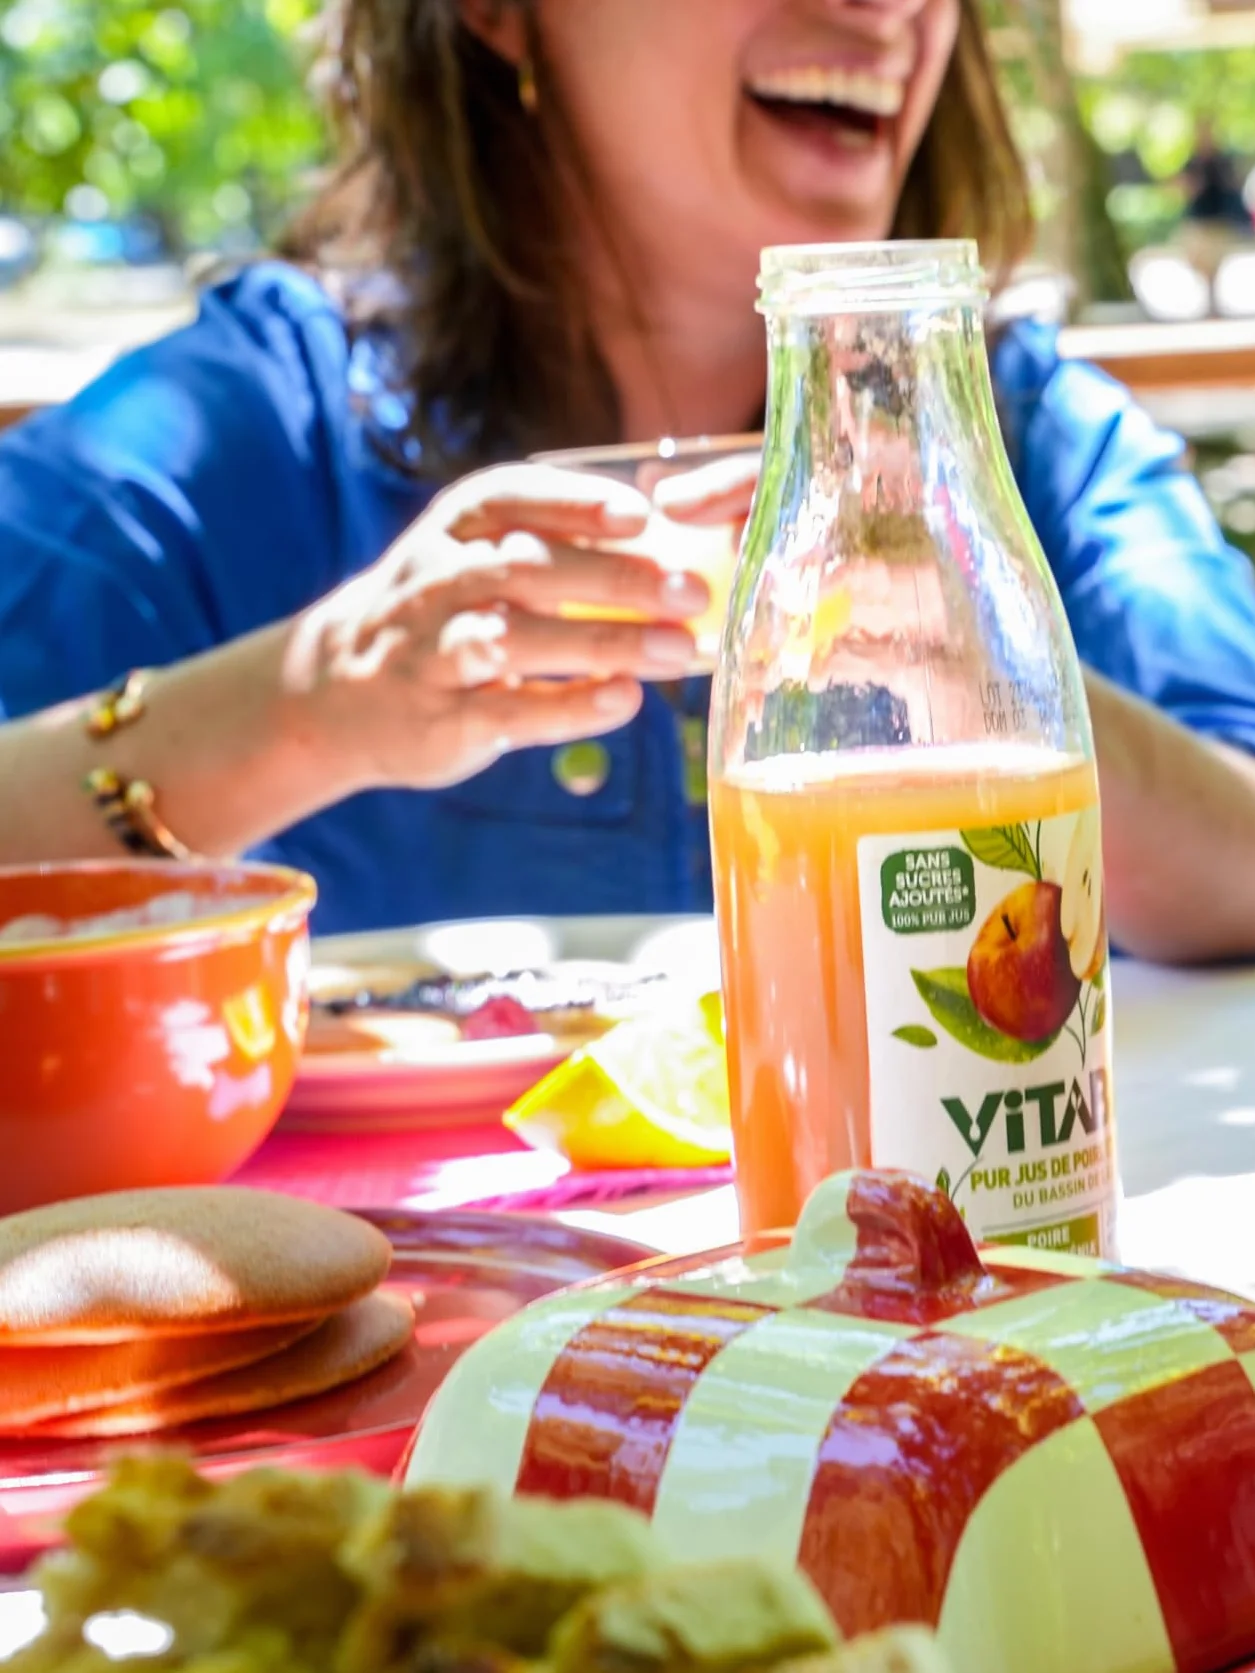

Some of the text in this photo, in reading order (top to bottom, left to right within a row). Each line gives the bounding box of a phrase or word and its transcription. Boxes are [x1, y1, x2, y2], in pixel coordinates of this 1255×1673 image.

[905, 851, 950, 871] SANS
[896, 868, 962, 890] SUCRES
[892, 907, 970, 928] 100% PUR JUS
[970, 1167, 1011, 1192] PUR
[1014, 1159, 1047, 1186] JUS
[1050, 1153, 1071, 1178] DE
[1013, 1190, 1034, 1209] DU
[1039, 1178, 1085, 1204] BASSIN
[1027, 1223, 1070, 1250] POIRE
